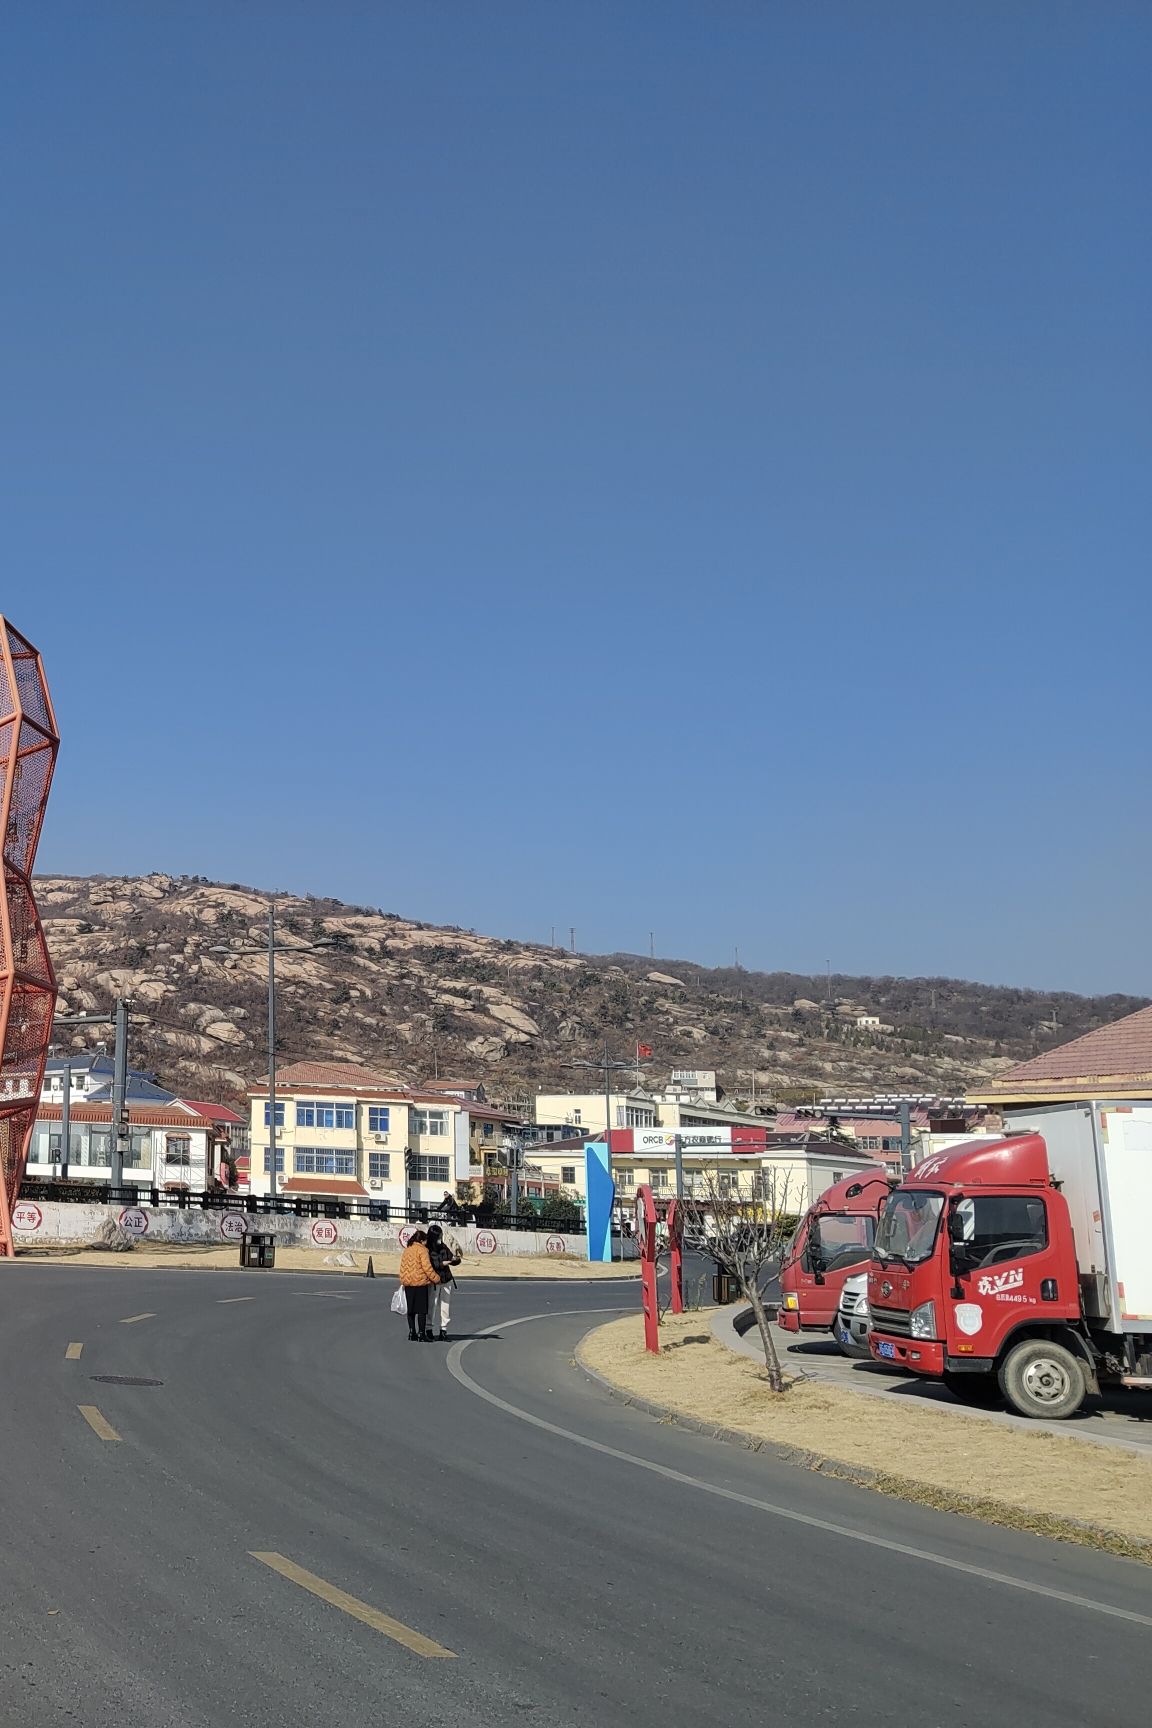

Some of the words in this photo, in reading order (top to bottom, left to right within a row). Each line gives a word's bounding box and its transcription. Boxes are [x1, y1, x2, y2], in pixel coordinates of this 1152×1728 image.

[642, 1135, 664, 1144] ORCB
[15, 1211, 37, 1224] 平等
[123, 1216, 144, 1228] 公正
[225, 1220, 243, 1233] 法治
[315, 1227, 333, 1239] 爱国
[478, 1236, 493, 1247] 诚信
[548, 1241, 562, 1251] 友善
